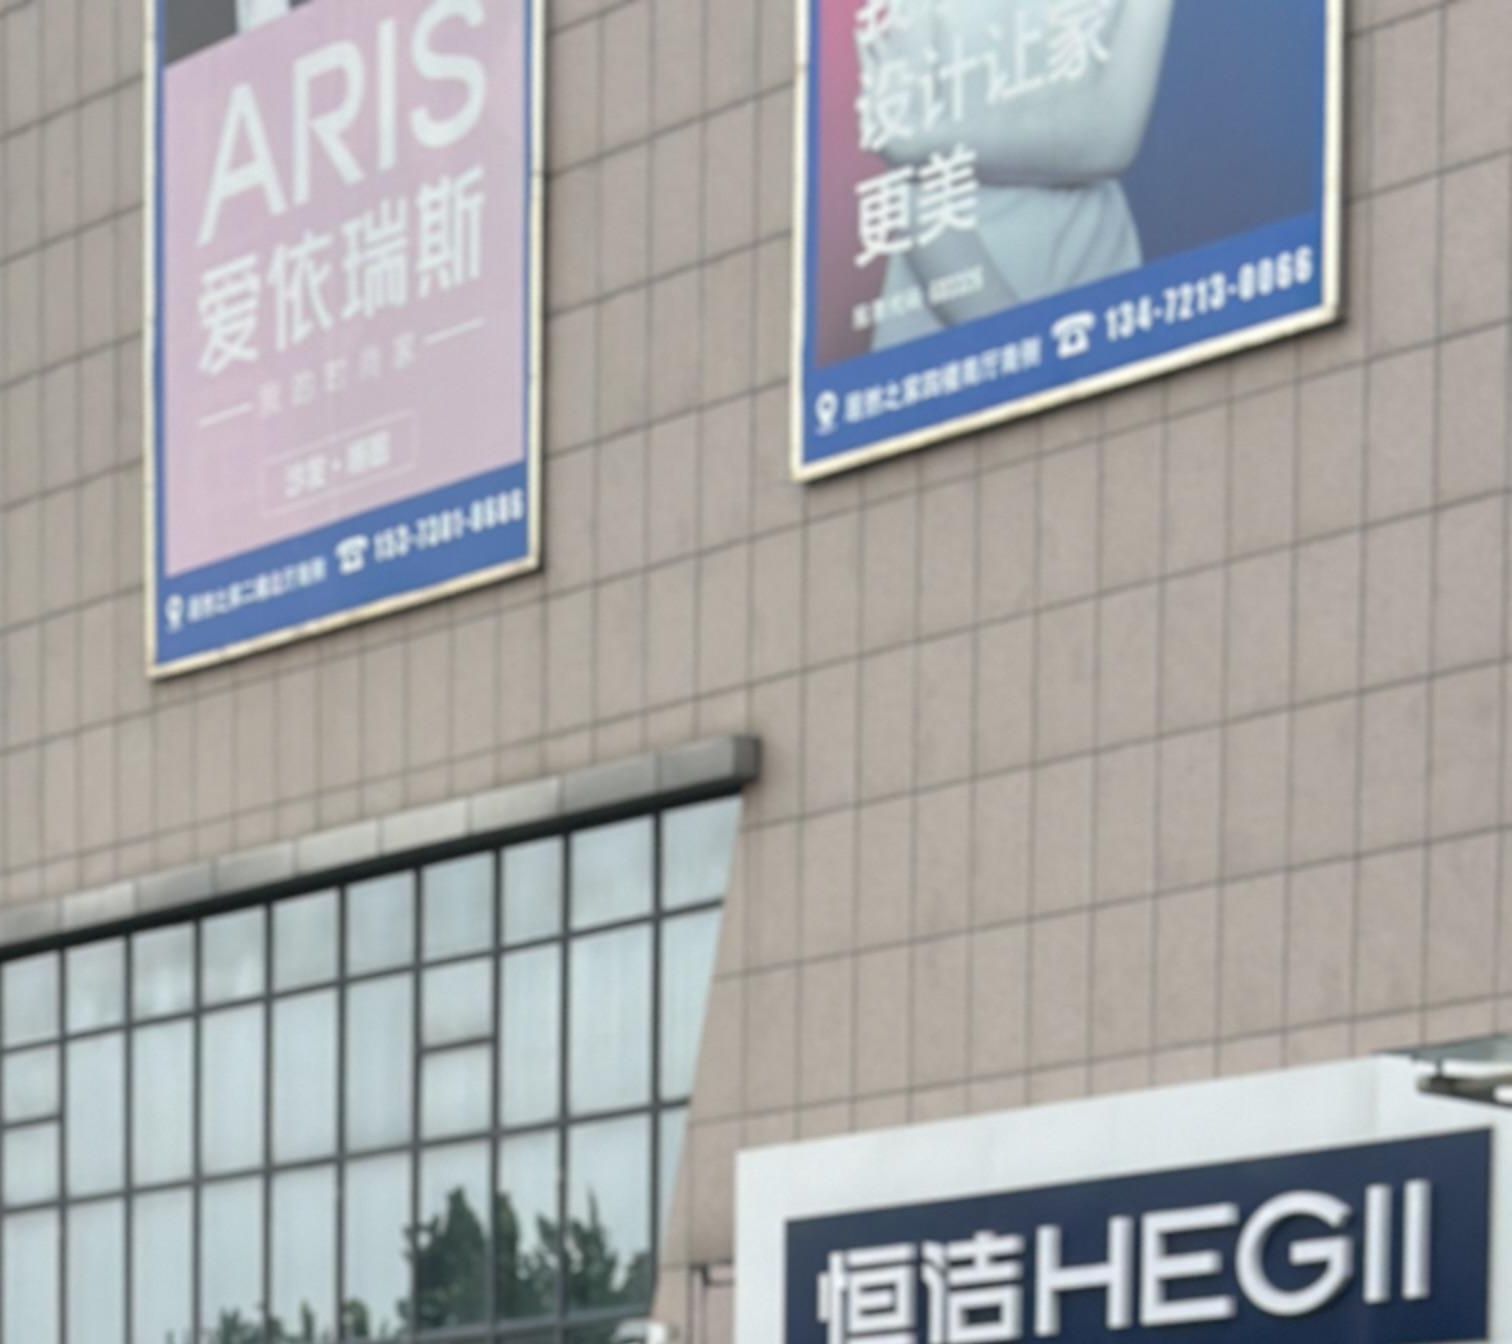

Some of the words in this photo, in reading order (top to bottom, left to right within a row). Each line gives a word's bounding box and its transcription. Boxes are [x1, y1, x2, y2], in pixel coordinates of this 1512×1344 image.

[197, 0, 486, 248] ARIS
[854, 143, 979, 268] 更美
[197, 163, 485, 376] 爱依瑞斯
[1034, 1179, 1430, 1337] HEGII
